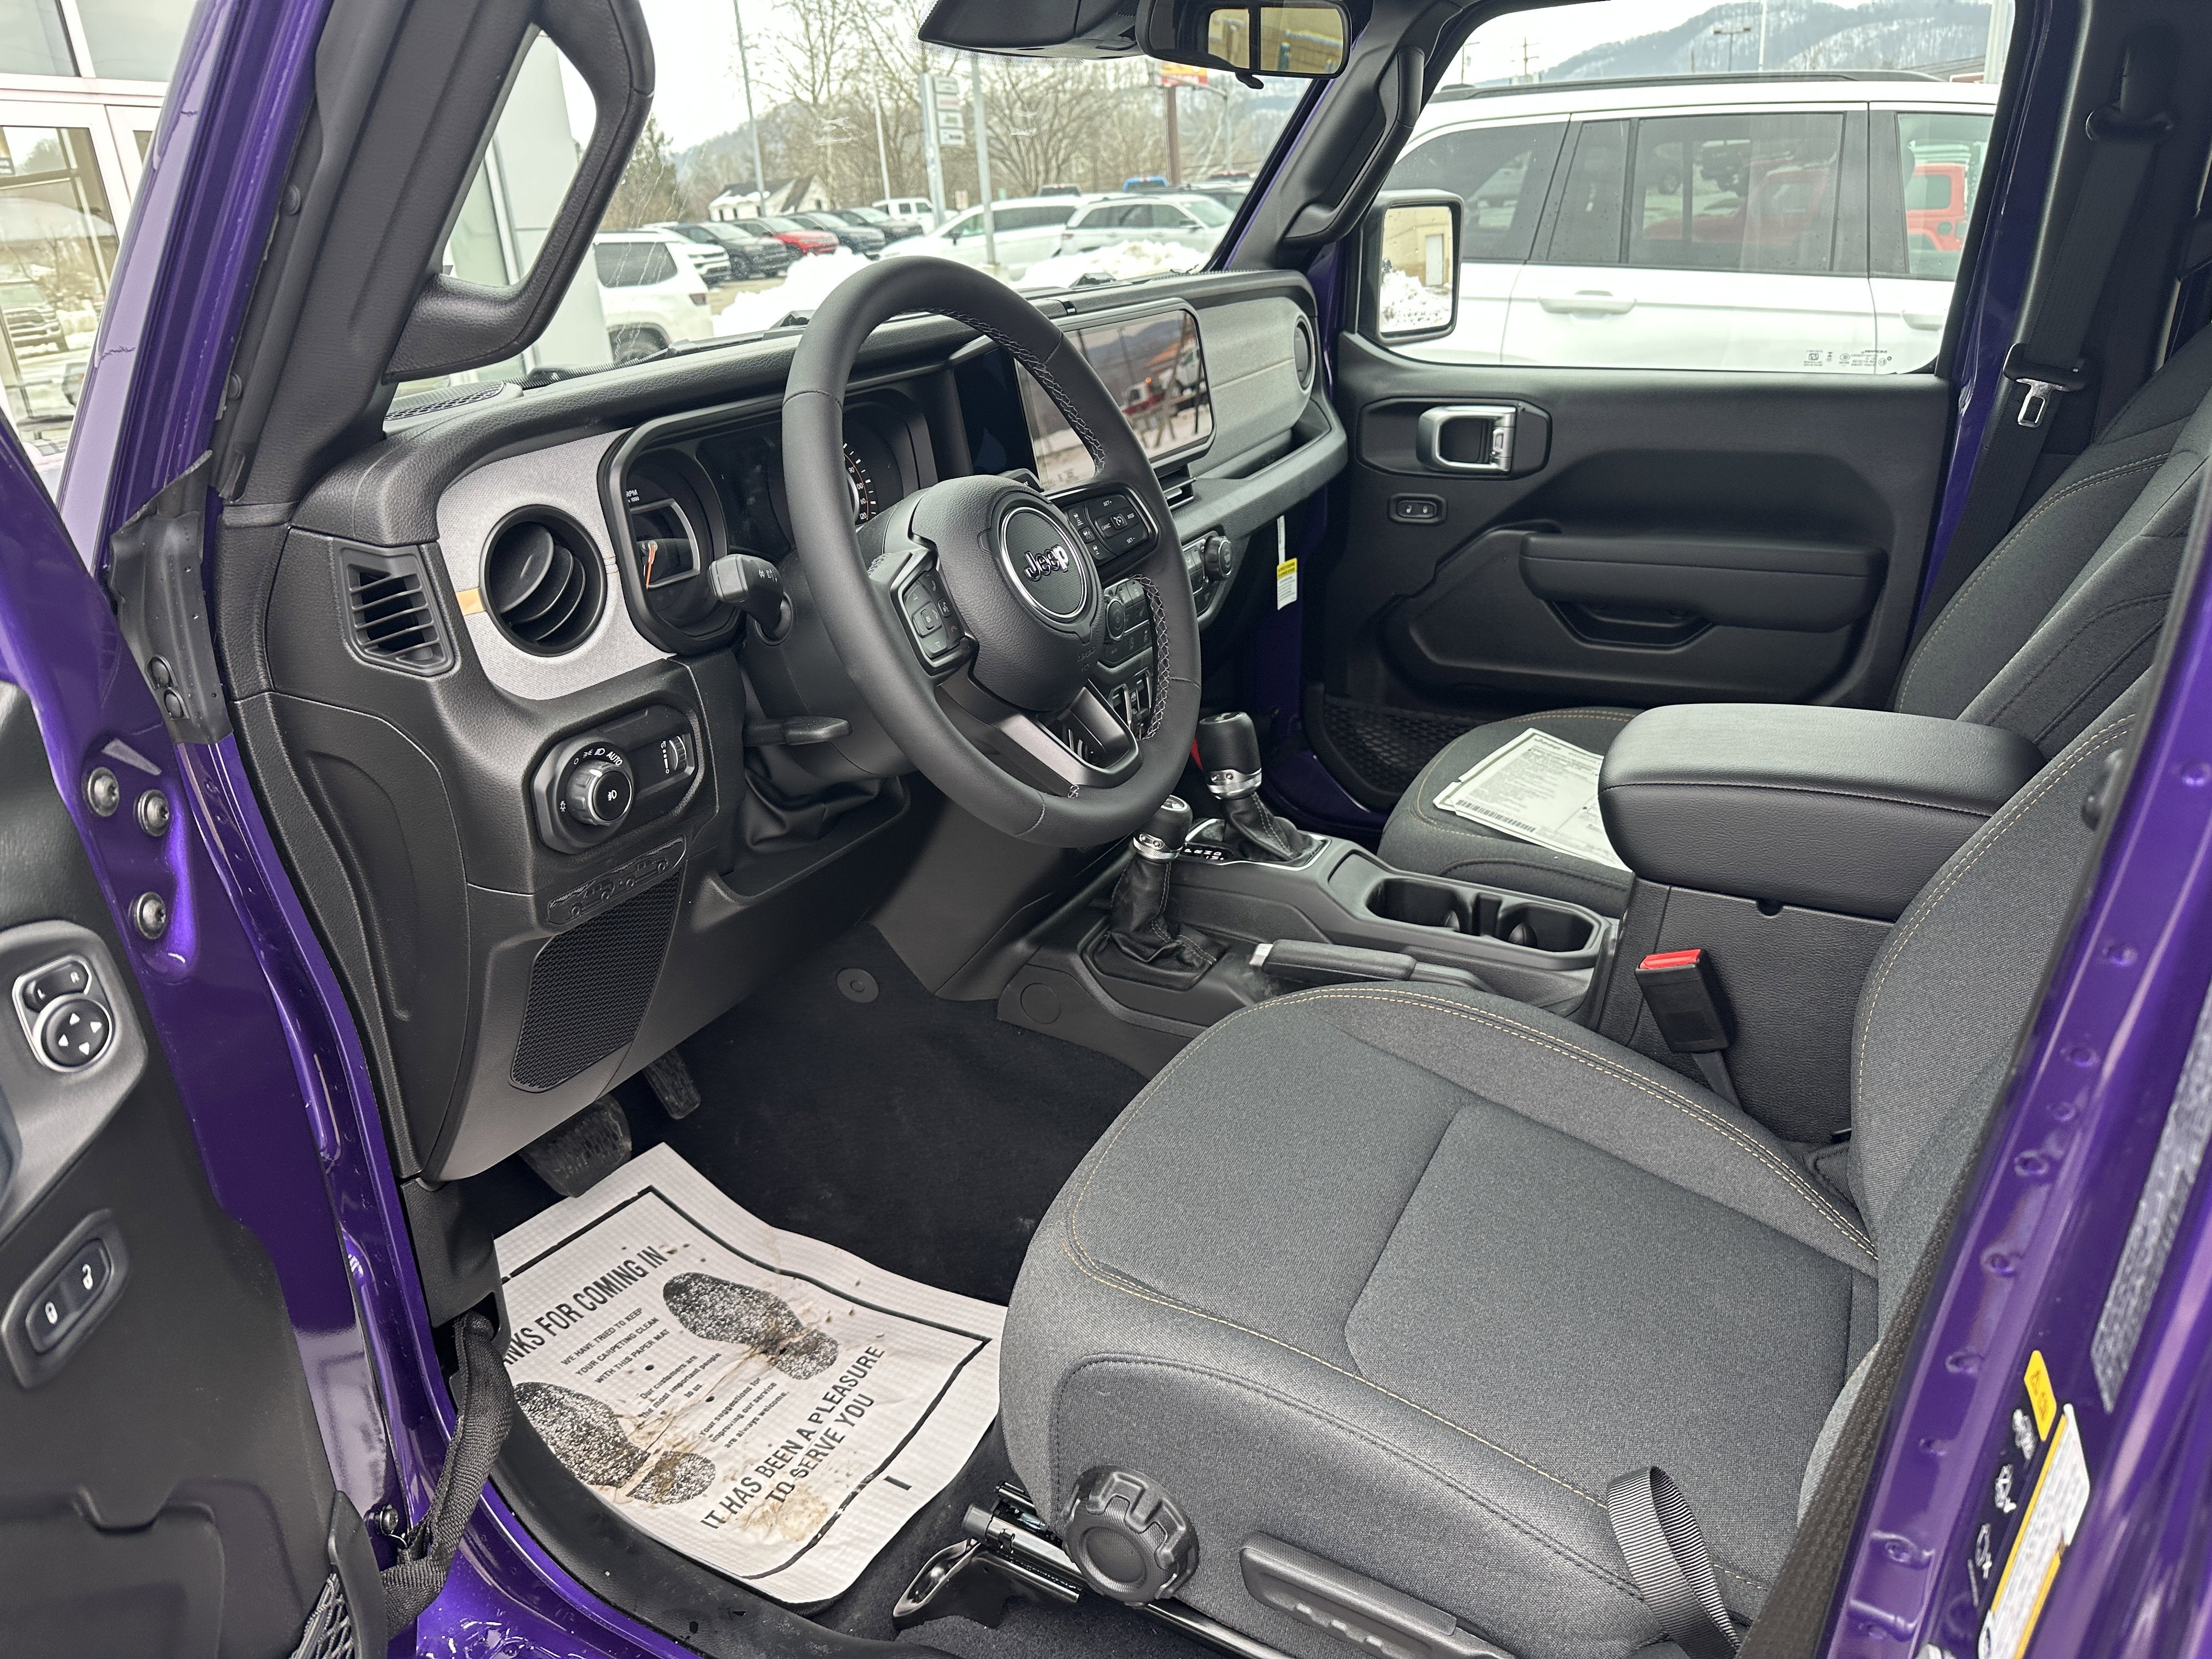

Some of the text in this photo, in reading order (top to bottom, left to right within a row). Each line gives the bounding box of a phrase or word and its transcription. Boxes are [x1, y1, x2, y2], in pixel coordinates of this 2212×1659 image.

[1024, 544, 1069, 582] Jeep
[606, 751, 623, 766] AUTO
[37, 988, 46, 1000] L
[70, 972, 80, 983] R
[534, 1303, 584, 1336] FOR
[573, 1260, 649, 1311] COMING
[637, 1246, 668, 1268] IN
[561, 1307, 642, 1365] WE HAVE TRIED TO KEEP
[575, 1317, 659, 1376] YOUR CARPETING CLEAN
[594, 1328, 670, 1384] WITH THIS PAPER MAT
[640, 1355, 698, 1399] Our customers are
[653, 1392, 671, 1408] most
[669, 1368, 701, 1393] important
[699, 1353, 722, 1369] people
[699, 1377, 761, 1436] Your suggestions for
[710, 1382, 777, 1442] improving our service
[724, 1391, 790, 1448] are always welcome.
[700, 1346, 885, 1529] IT HAS BEEN A PLEASURE
[765, 1393, 875, 1503] TO SERVE YOU
